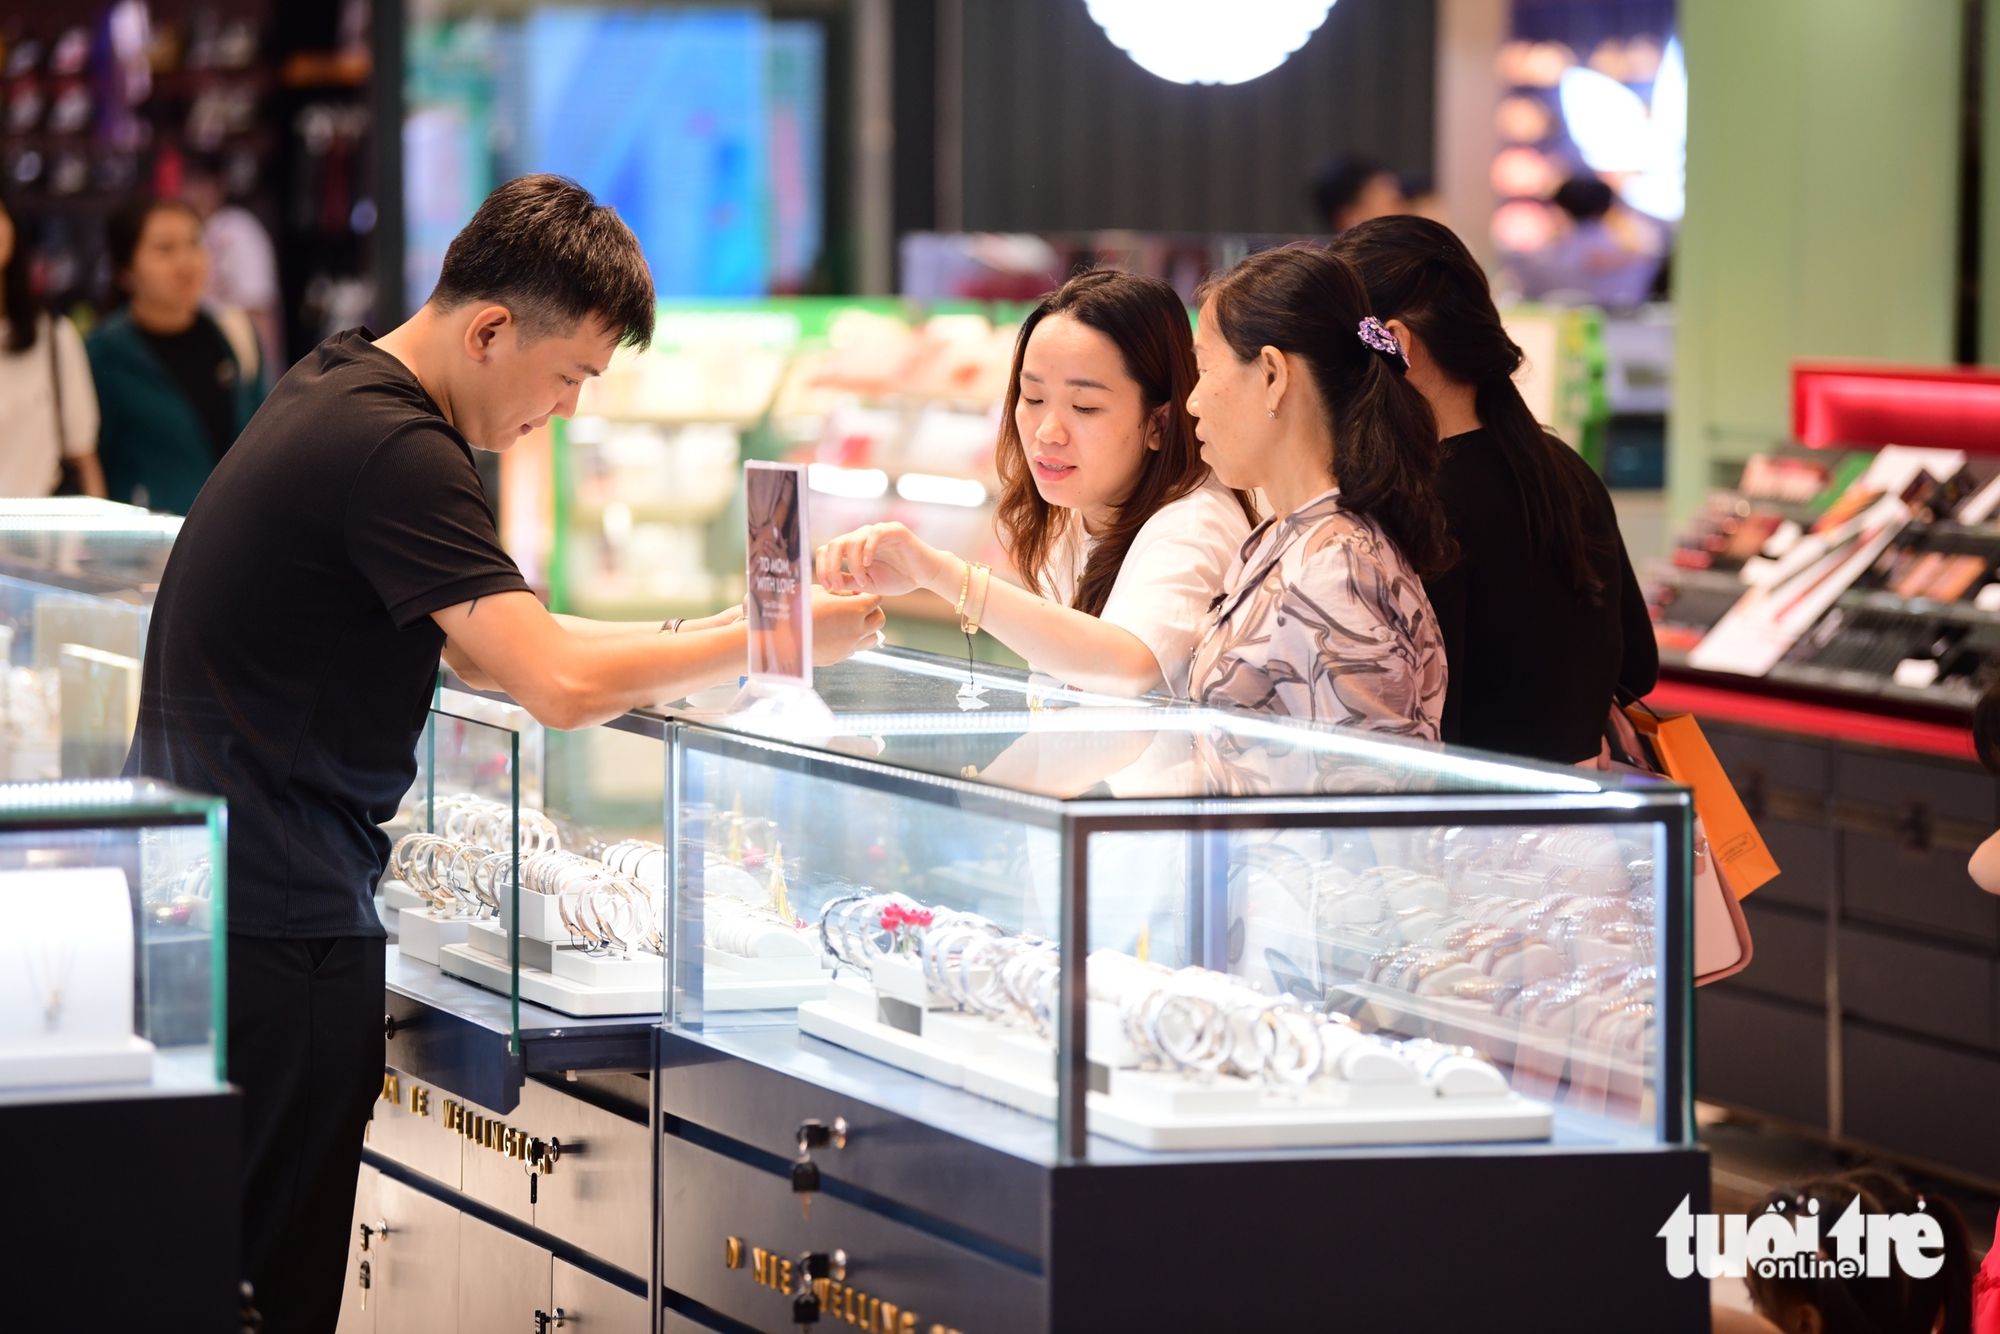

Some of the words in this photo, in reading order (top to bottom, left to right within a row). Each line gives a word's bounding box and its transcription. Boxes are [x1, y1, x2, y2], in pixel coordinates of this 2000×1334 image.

[759, 556, 770, 572] TO
[756, 576, 776, 592] WITH
[776, 578, 796, 594] LOVE
